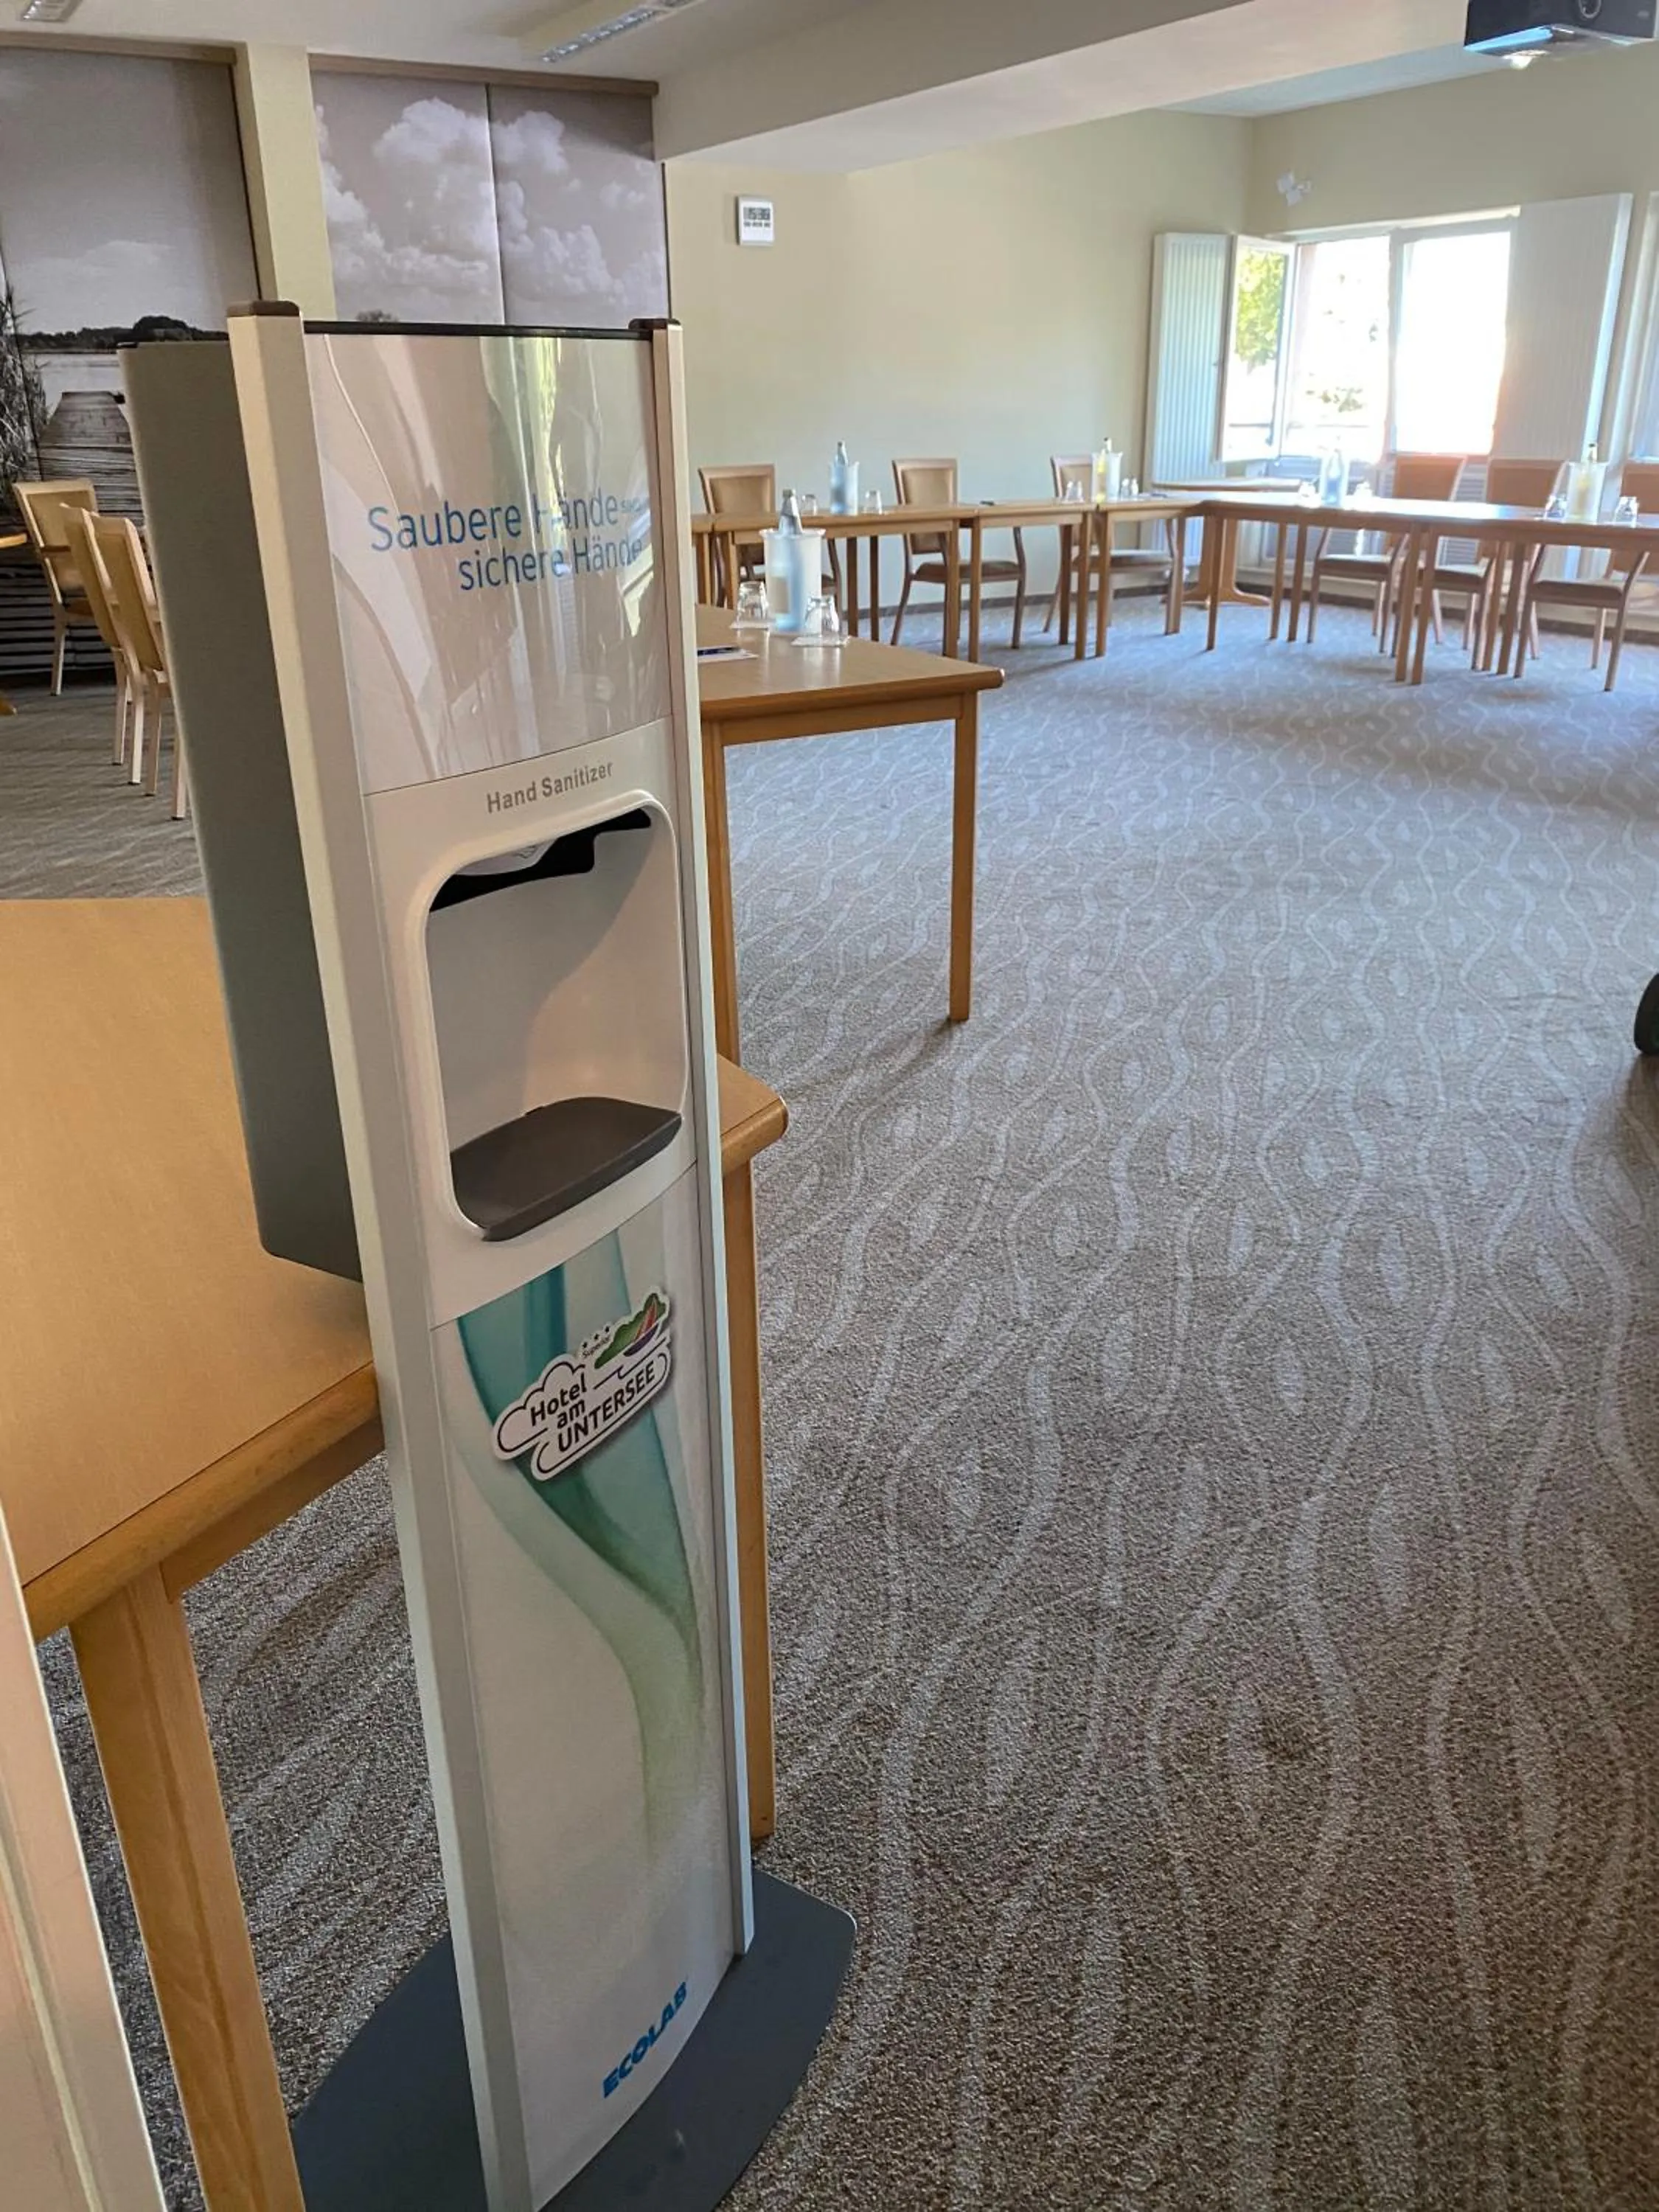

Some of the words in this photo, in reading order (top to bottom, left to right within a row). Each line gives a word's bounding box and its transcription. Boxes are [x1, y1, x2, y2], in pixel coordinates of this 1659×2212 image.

[369, 501, 521, 552] Saubere
[459, 547, 565, 591] sichere
[572, 535, 643, 575] Hände
[486, 780, 538, 813] Hand
[541, 762, 613, 798] Sanitizer
[530, 1372, 587, 1426] Hotel
[557, 1361, 655, 1452] UNTERSEE
[557, 1400, 585, 1429] am
[602, 1980, 687, 2099] ECOLAB
